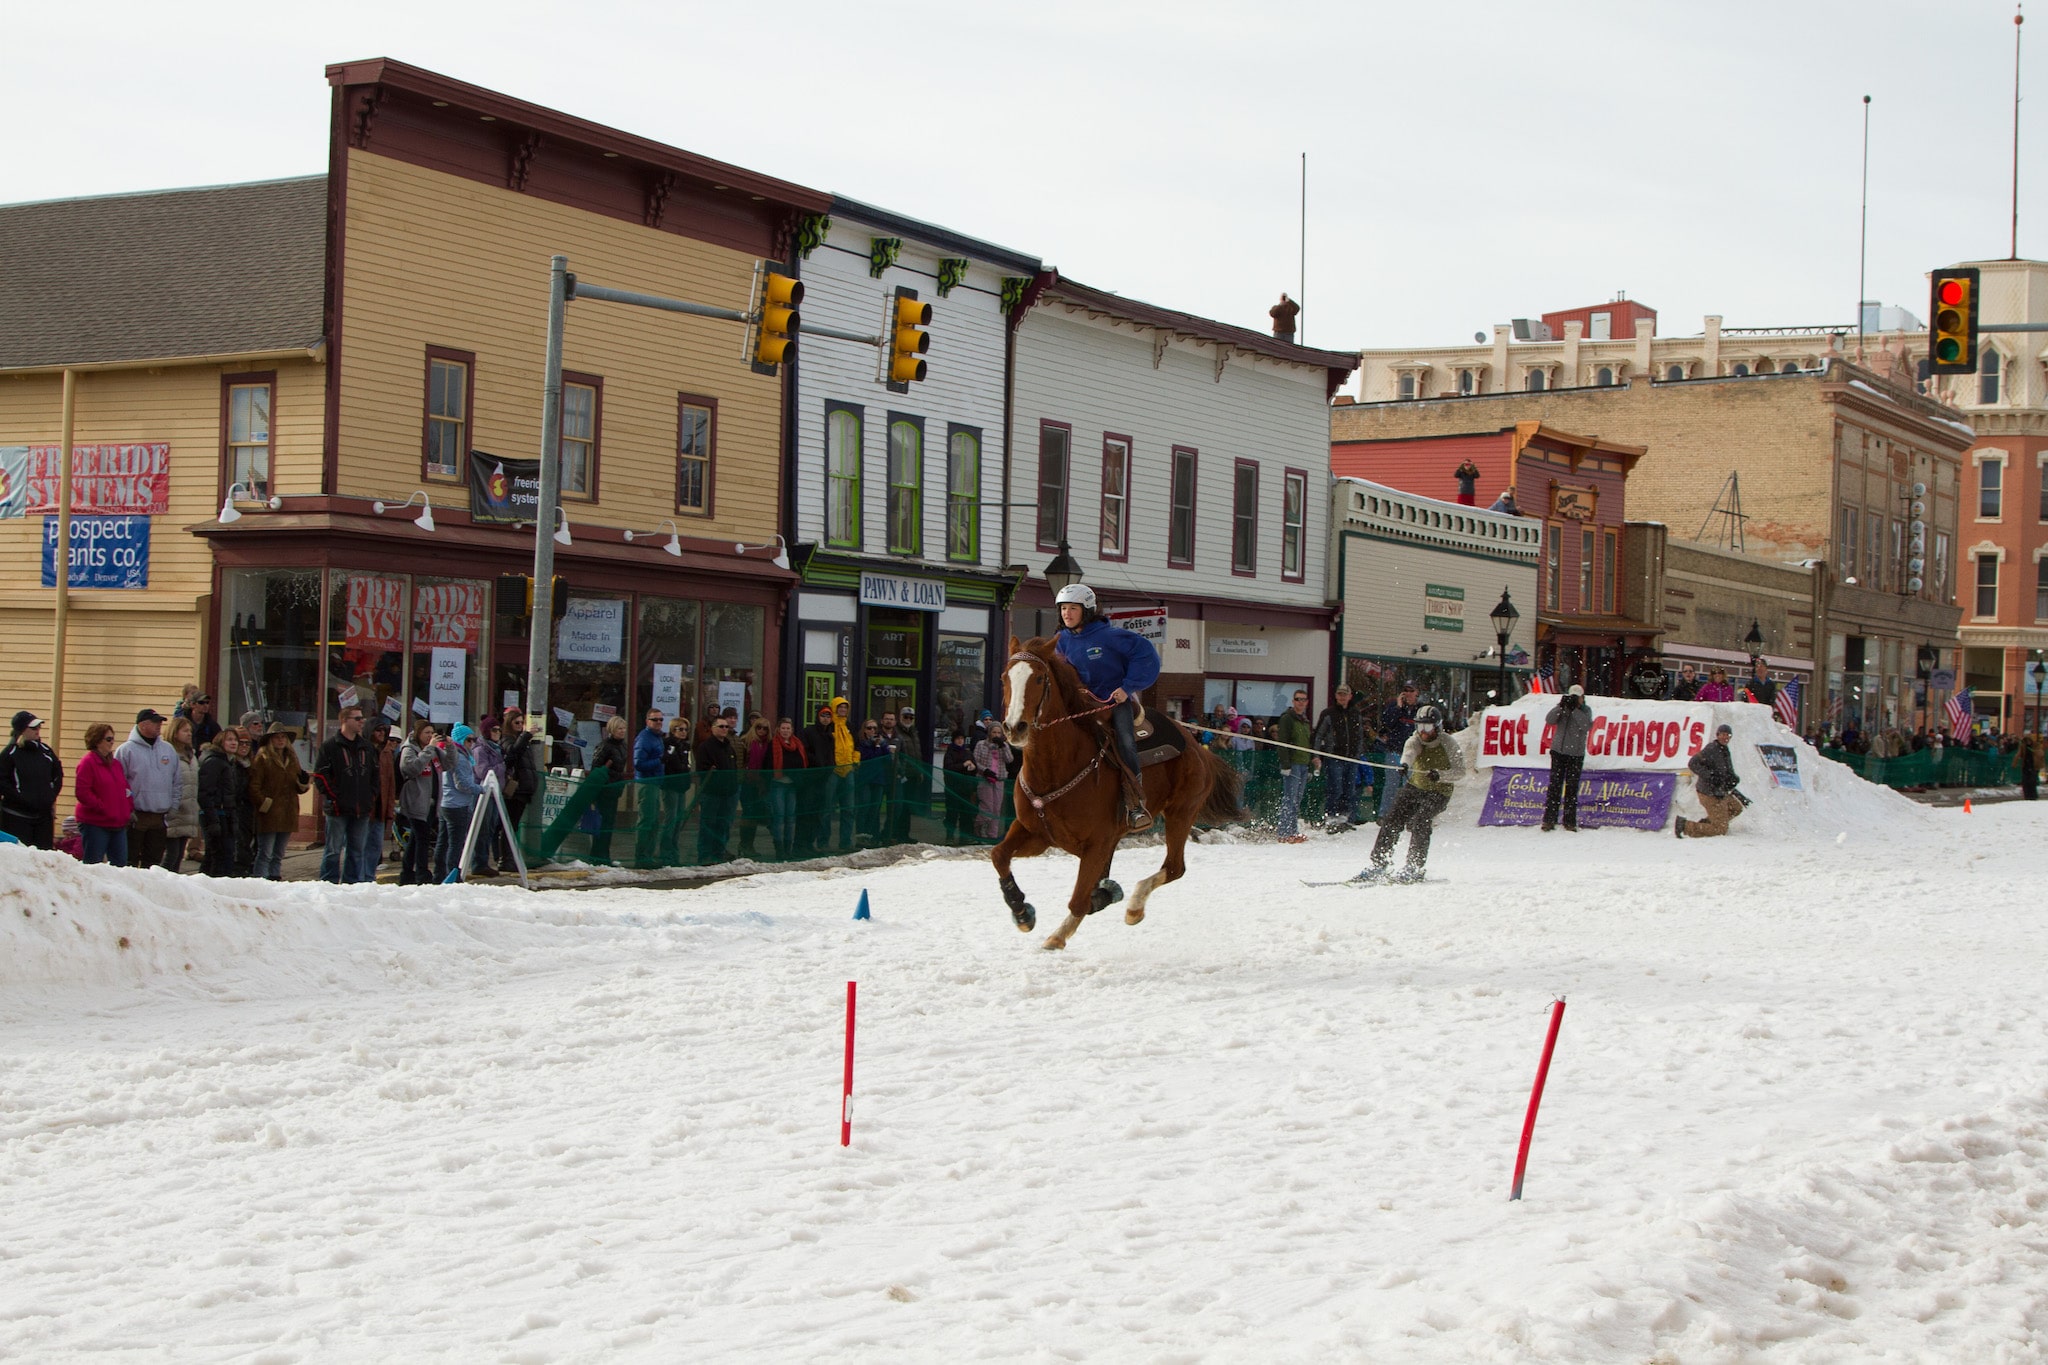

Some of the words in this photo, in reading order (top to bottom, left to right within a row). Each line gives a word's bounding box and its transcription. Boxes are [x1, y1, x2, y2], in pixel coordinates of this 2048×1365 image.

[48, 517, 133, 546] pospect
[112, 548, 140, 567] co.
[94, 573, 118, 582] Denver
[864, 577, 896, 600] PAWN
[901, 581, 909, 602] &
[914, 583, 943, 605] LOAN
[567, 606, 616, 620] Apparel
[1123, 619, 1153, 630] Coffee
[572, 631, 597, 641] Made
[882, 633, 904, 641] ART
[569, 643, 611, 653] Colorado
[875, 657, 912, 666] TOOLS
[660, 675, 675, 683] LOCAL
[435, 683, 460, 691] GALLERY
[874, 689, 908, 697] COINS
[1483, 714, 1529, 756] Eat
[1586, 714, 1705, 763] Gringo's
[1597, 780, 1653, 801] Altitude
[1581, 804, 1598, 813] and
